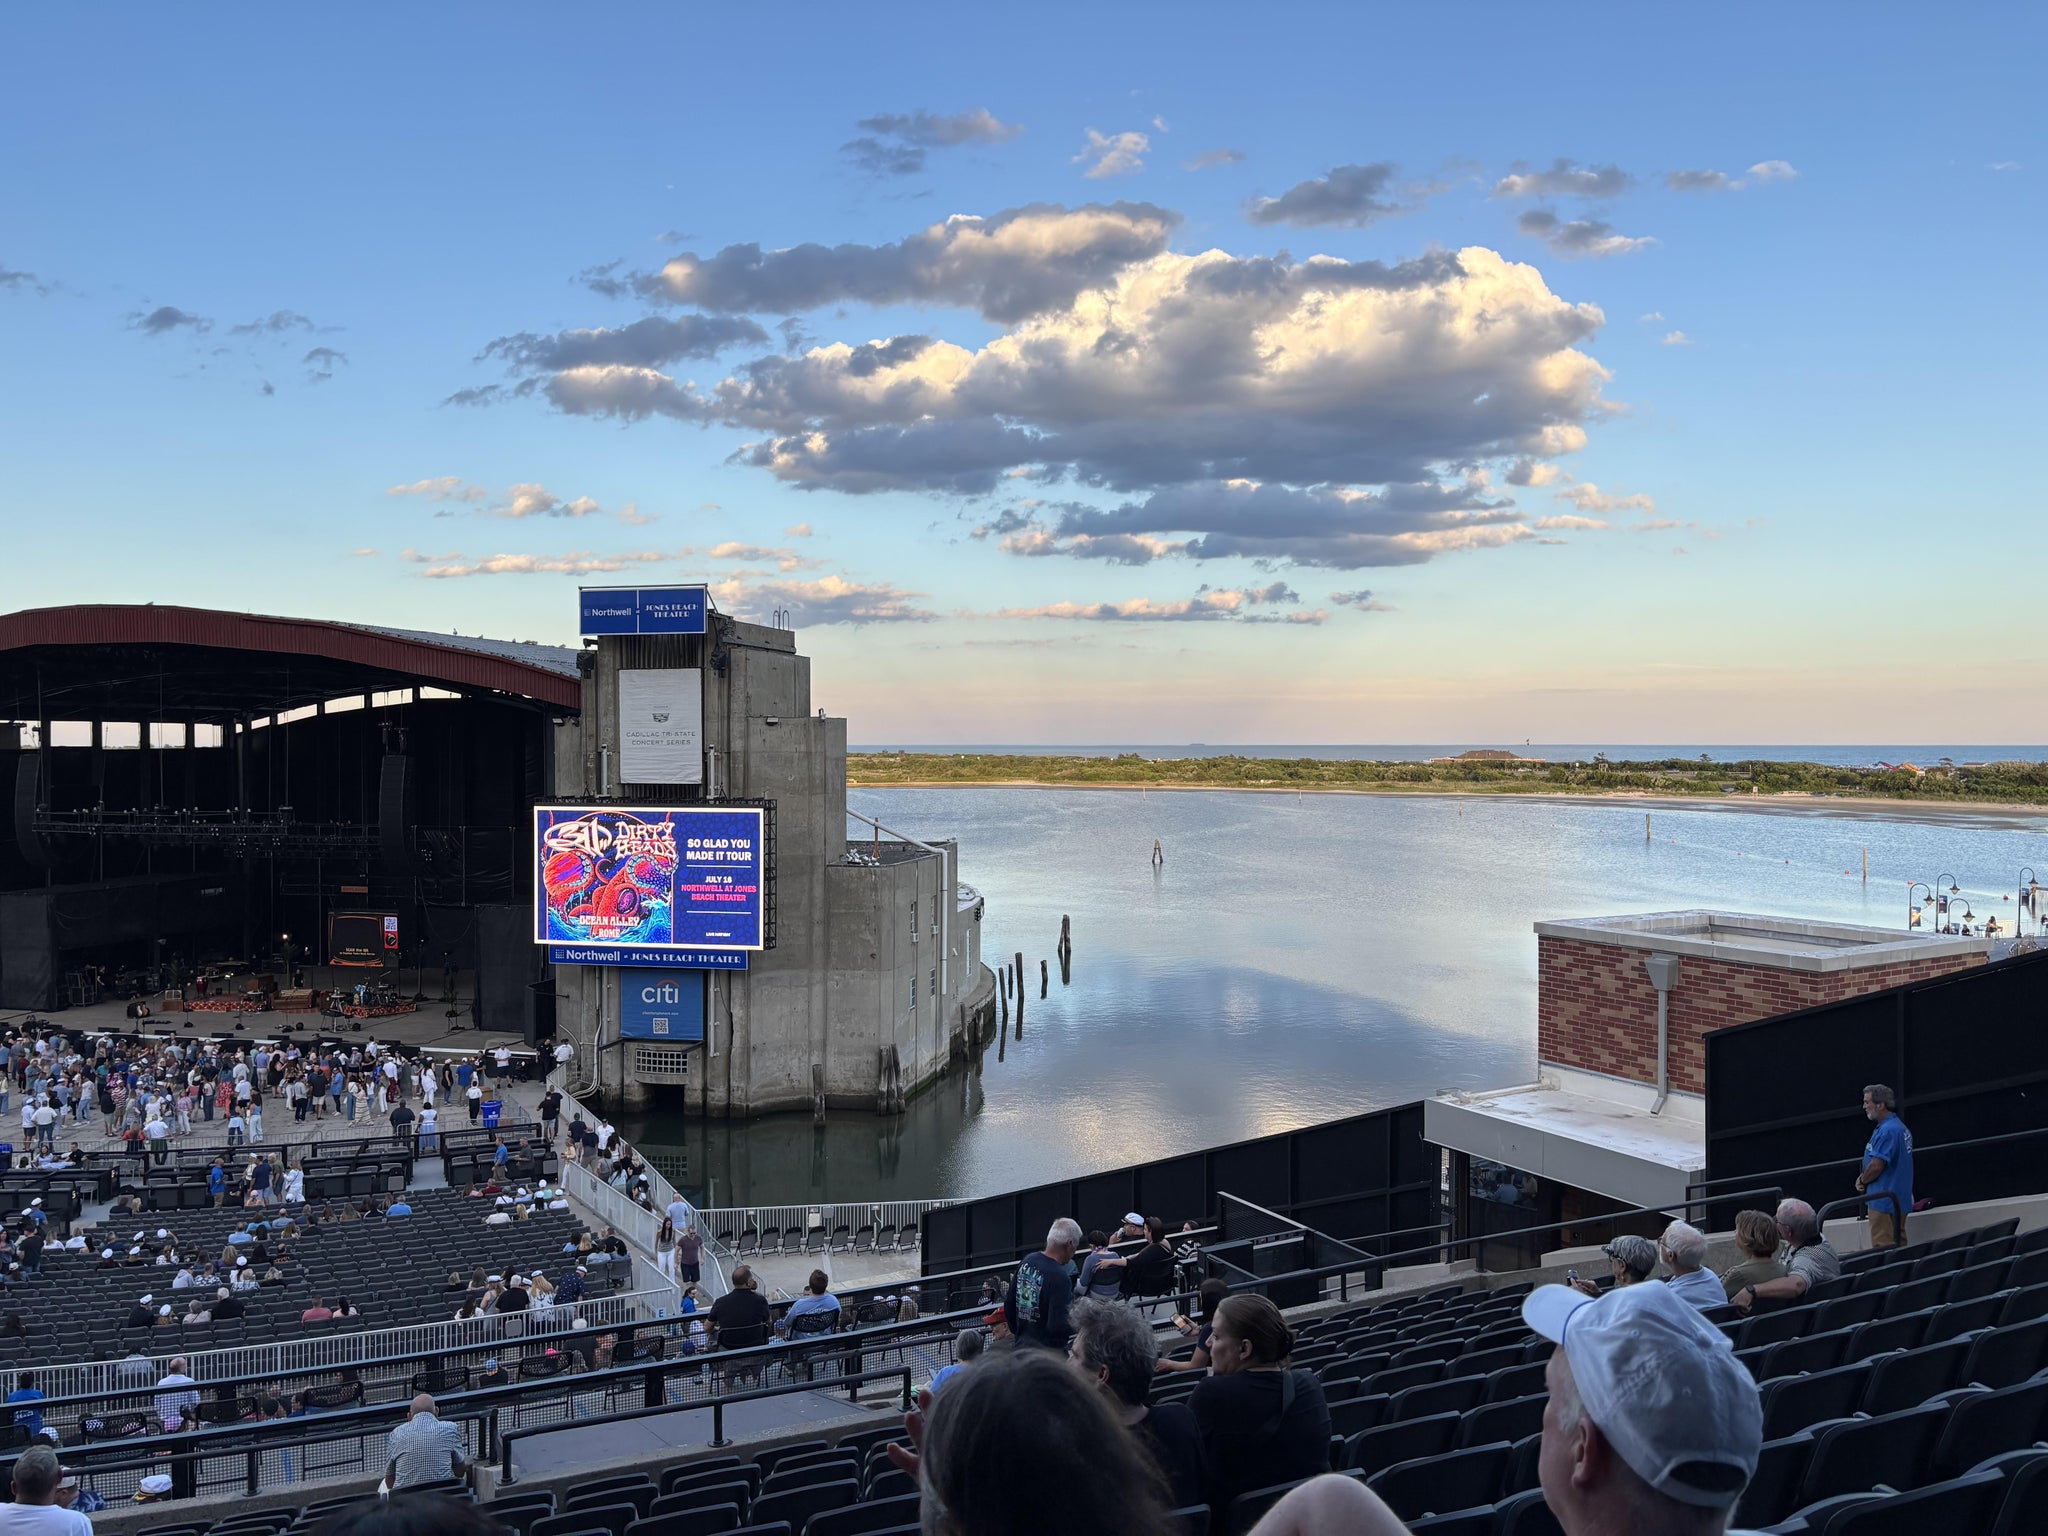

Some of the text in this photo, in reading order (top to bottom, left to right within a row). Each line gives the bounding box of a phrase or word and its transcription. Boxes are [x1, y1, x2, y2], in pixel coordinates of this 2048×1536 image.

[592, 608, 632, 617] Northwell
[645, 603, 698, 612] JONES BEACH
[614, 821, 676, 841] DIRTY
[687, 838, 751, 849] SO GLAD YOU
[612, 839, 677, 860] HEADS
[686, 850, 752, 861] MADE IT TOUR
[705, 875, 722, 883] JULY
[681, 884, 723, 892] NORTHWELL
[734, 885, 757, 893] JONES
[691, 893, 747, 902] BEACH THEATER
[579, 915, 640, 927] OCEAN ALLEY
[598, 928, 621, 938] ROME
[566, 949, 620, 962] Northwell
[630, 953, 661, 961] JONES
[662, 953, 695, 962] BEACH
[697, 954, 742, 964] THEATER
[641, 983, 680, 1004] citi
[658, 1309, 664, 1318] E
